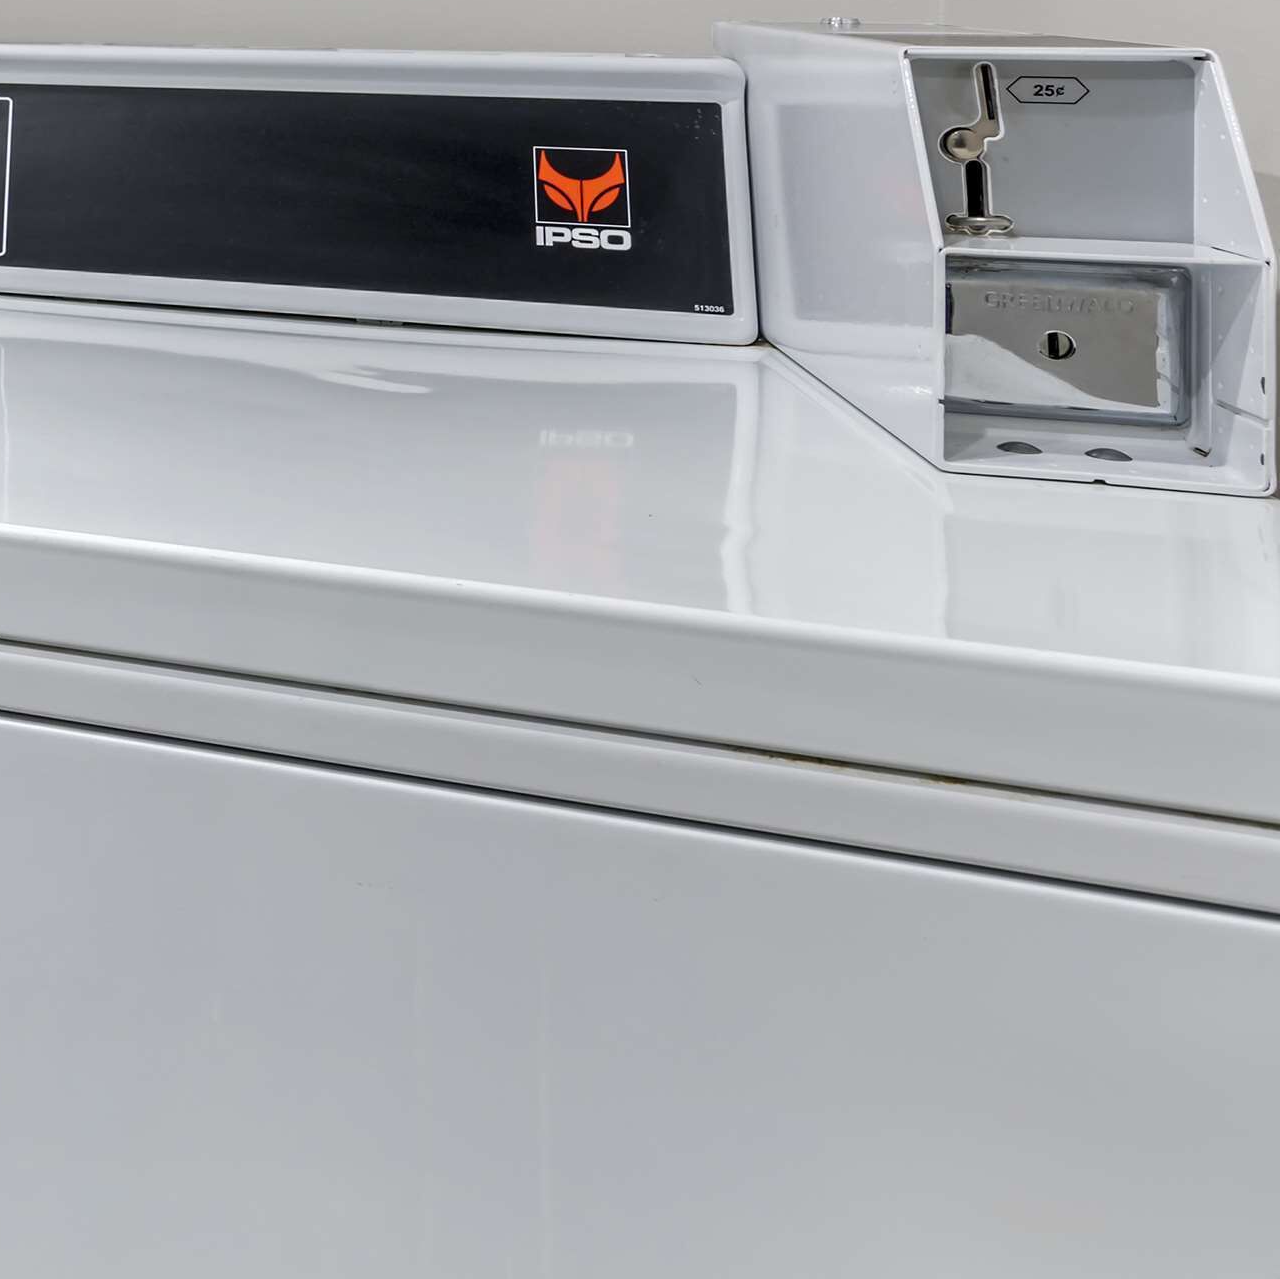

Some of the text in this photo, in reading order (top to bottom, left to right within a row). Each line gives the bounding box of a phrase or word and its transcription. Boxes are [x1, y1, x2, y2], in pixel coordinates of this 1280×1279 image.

[1033, 84, 1065, 97] 25¢
[535, 225, 632, 251] IPSO
[694, 304, 725, 313] 513036
